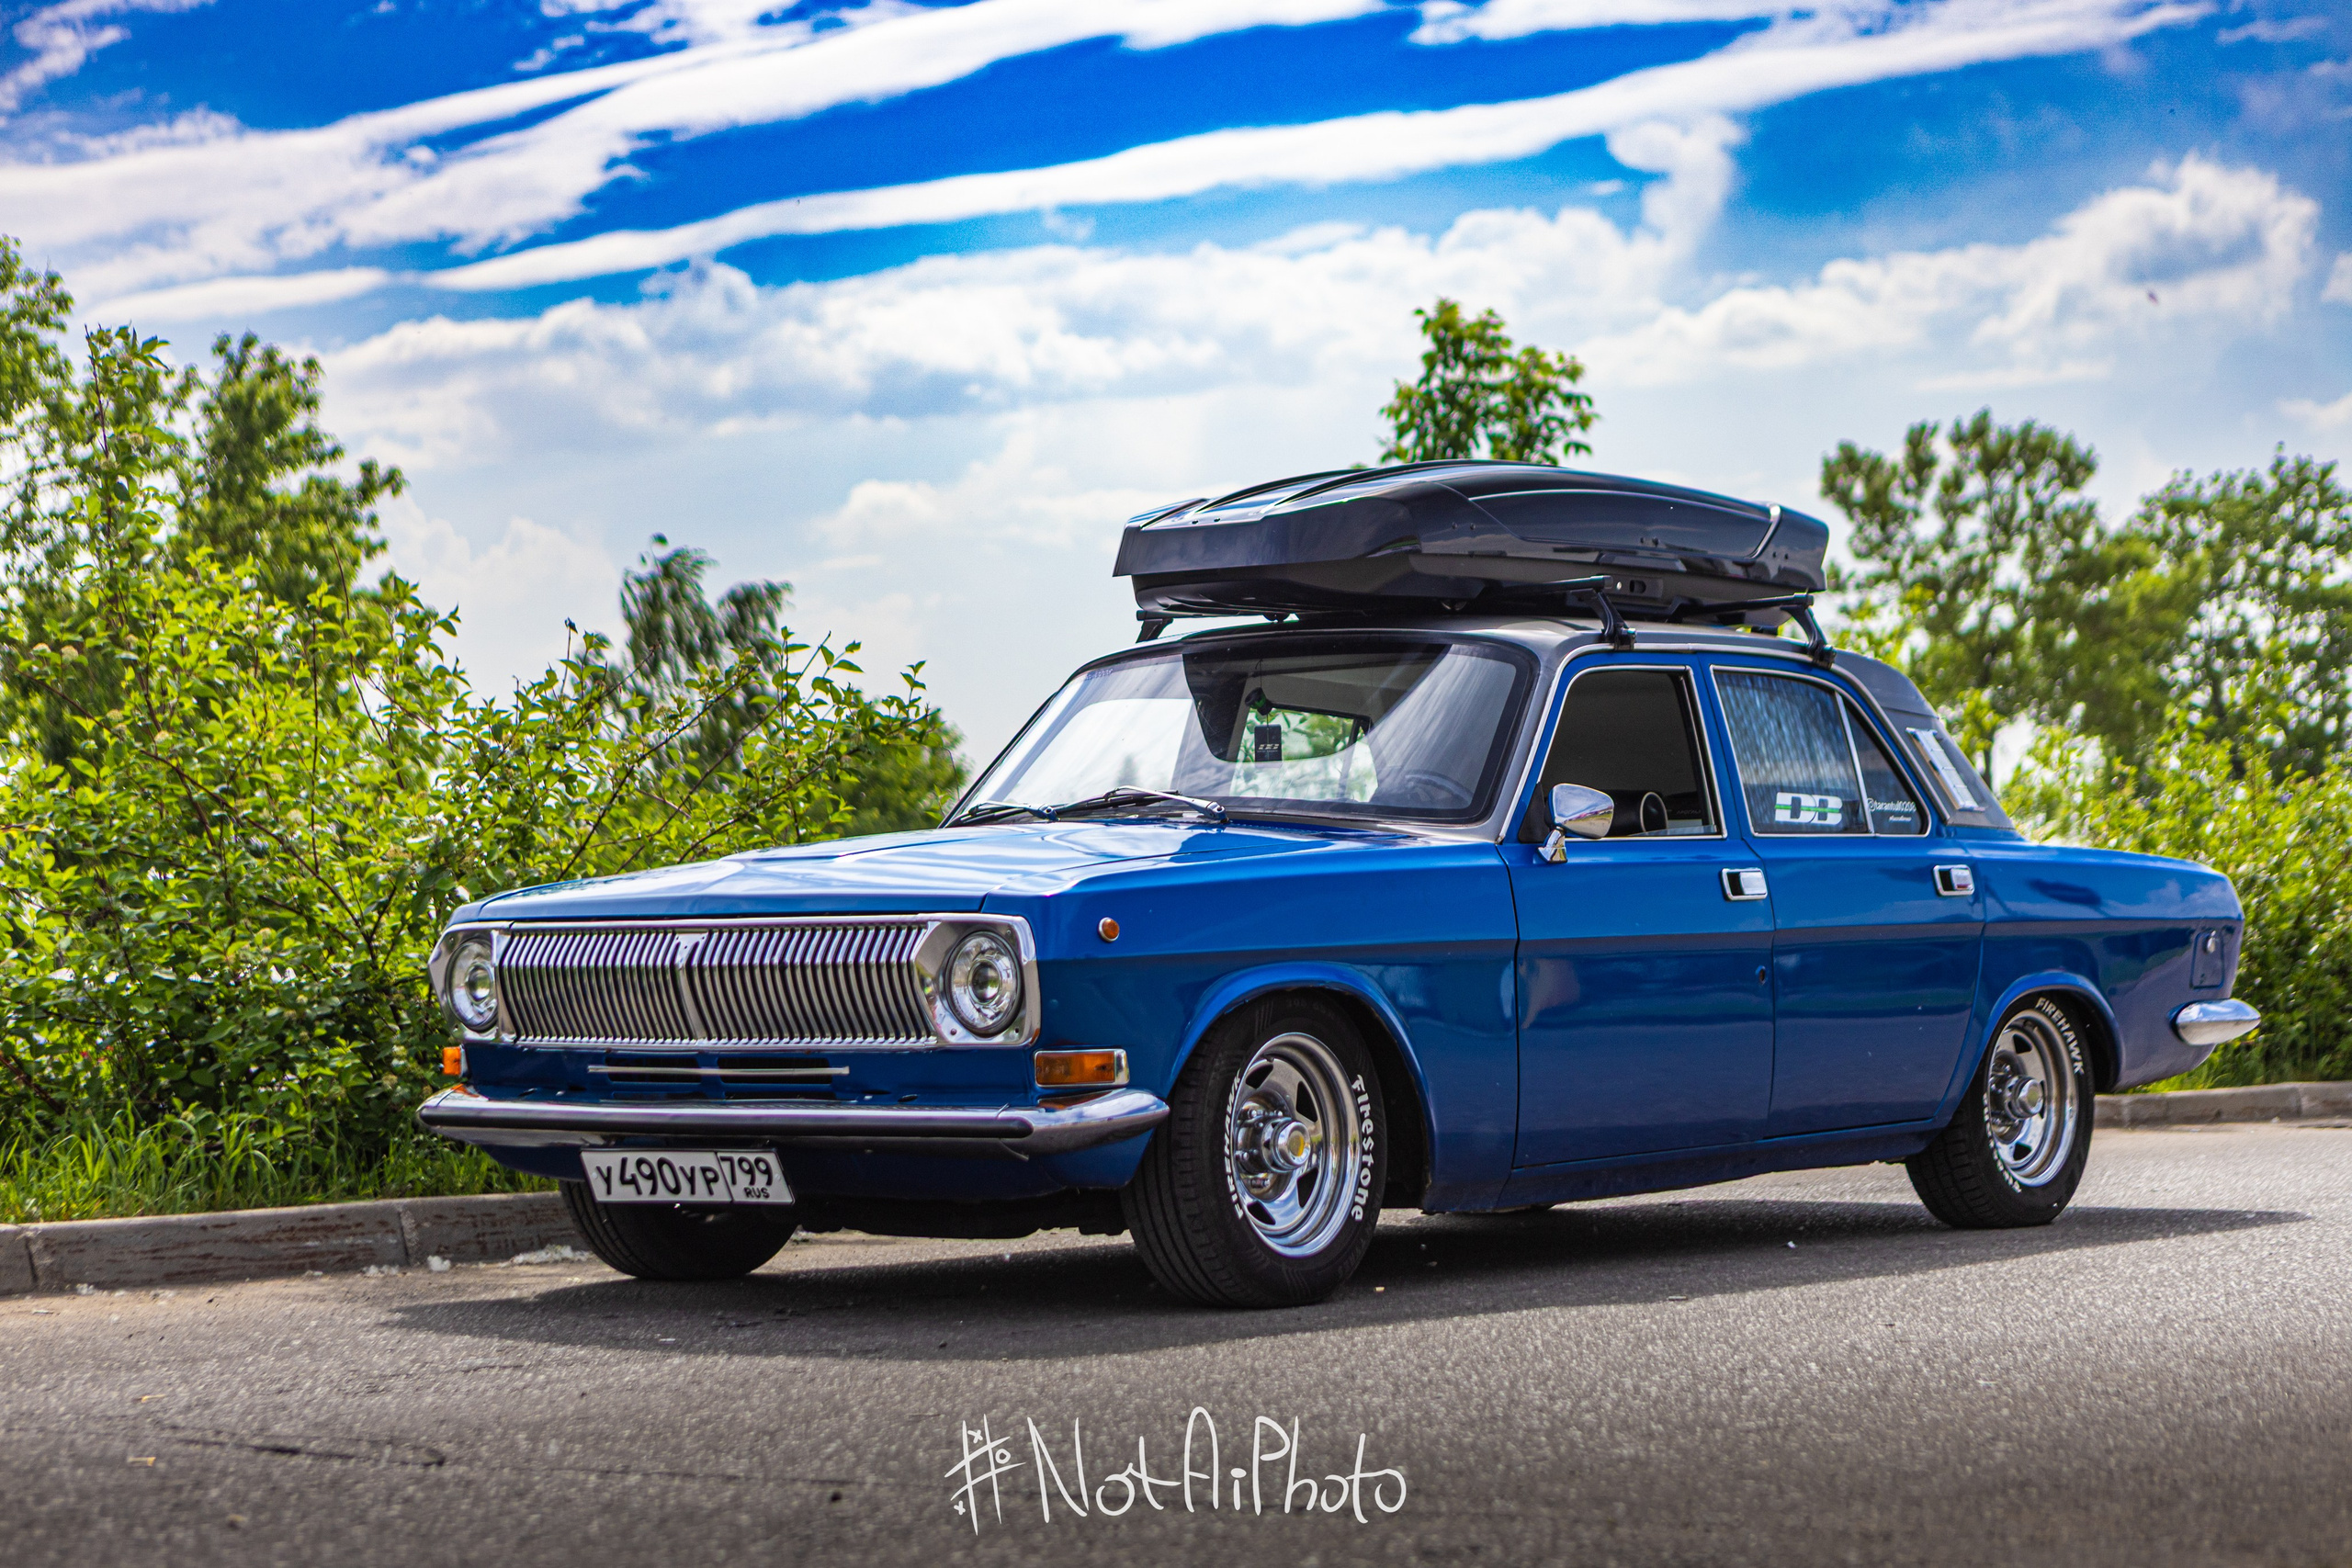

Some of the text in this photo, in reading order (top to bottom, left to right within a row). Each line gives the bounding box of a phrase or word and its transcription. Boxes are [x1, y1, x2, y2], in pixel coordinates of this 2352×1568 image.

[2035, 997, 2085, 1076] FIREHAWK
[719, 1156, 774, 1186] 799
[1224, 1068, 1244, 1220] FIREHAWK
[1351, 1074, 1374, 1222] Firestone
[743, 1186, 771, 1199] RUS
